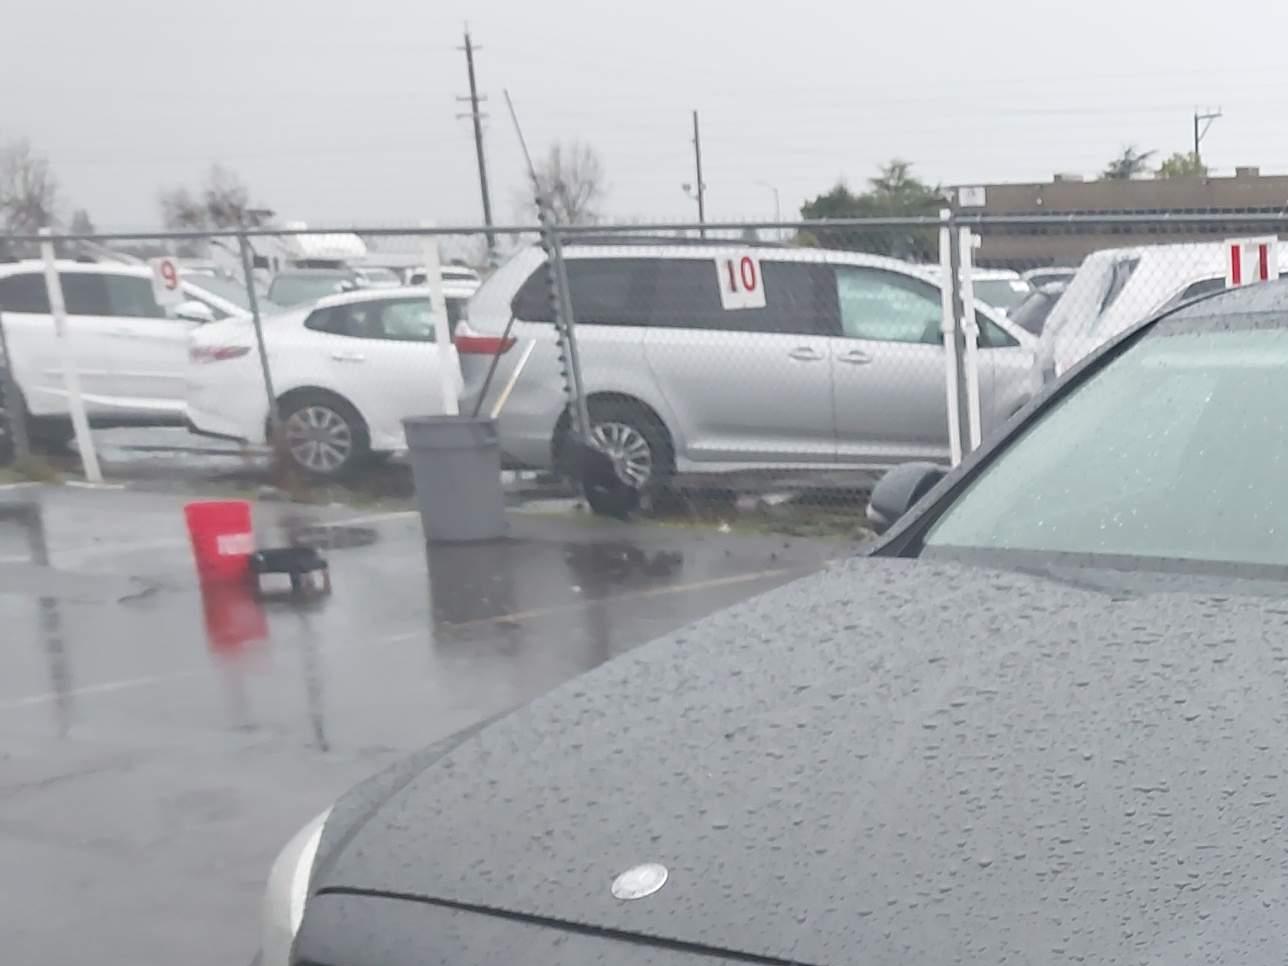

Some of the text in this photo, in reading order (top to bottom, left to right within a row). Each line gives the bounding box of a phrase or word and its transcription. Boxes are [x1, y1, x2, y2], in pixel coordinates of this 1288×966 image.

[161, 260, 177, 290] 9
[726, 256, 755, 292] 10
[1231, 244, 1268, 285] 11
